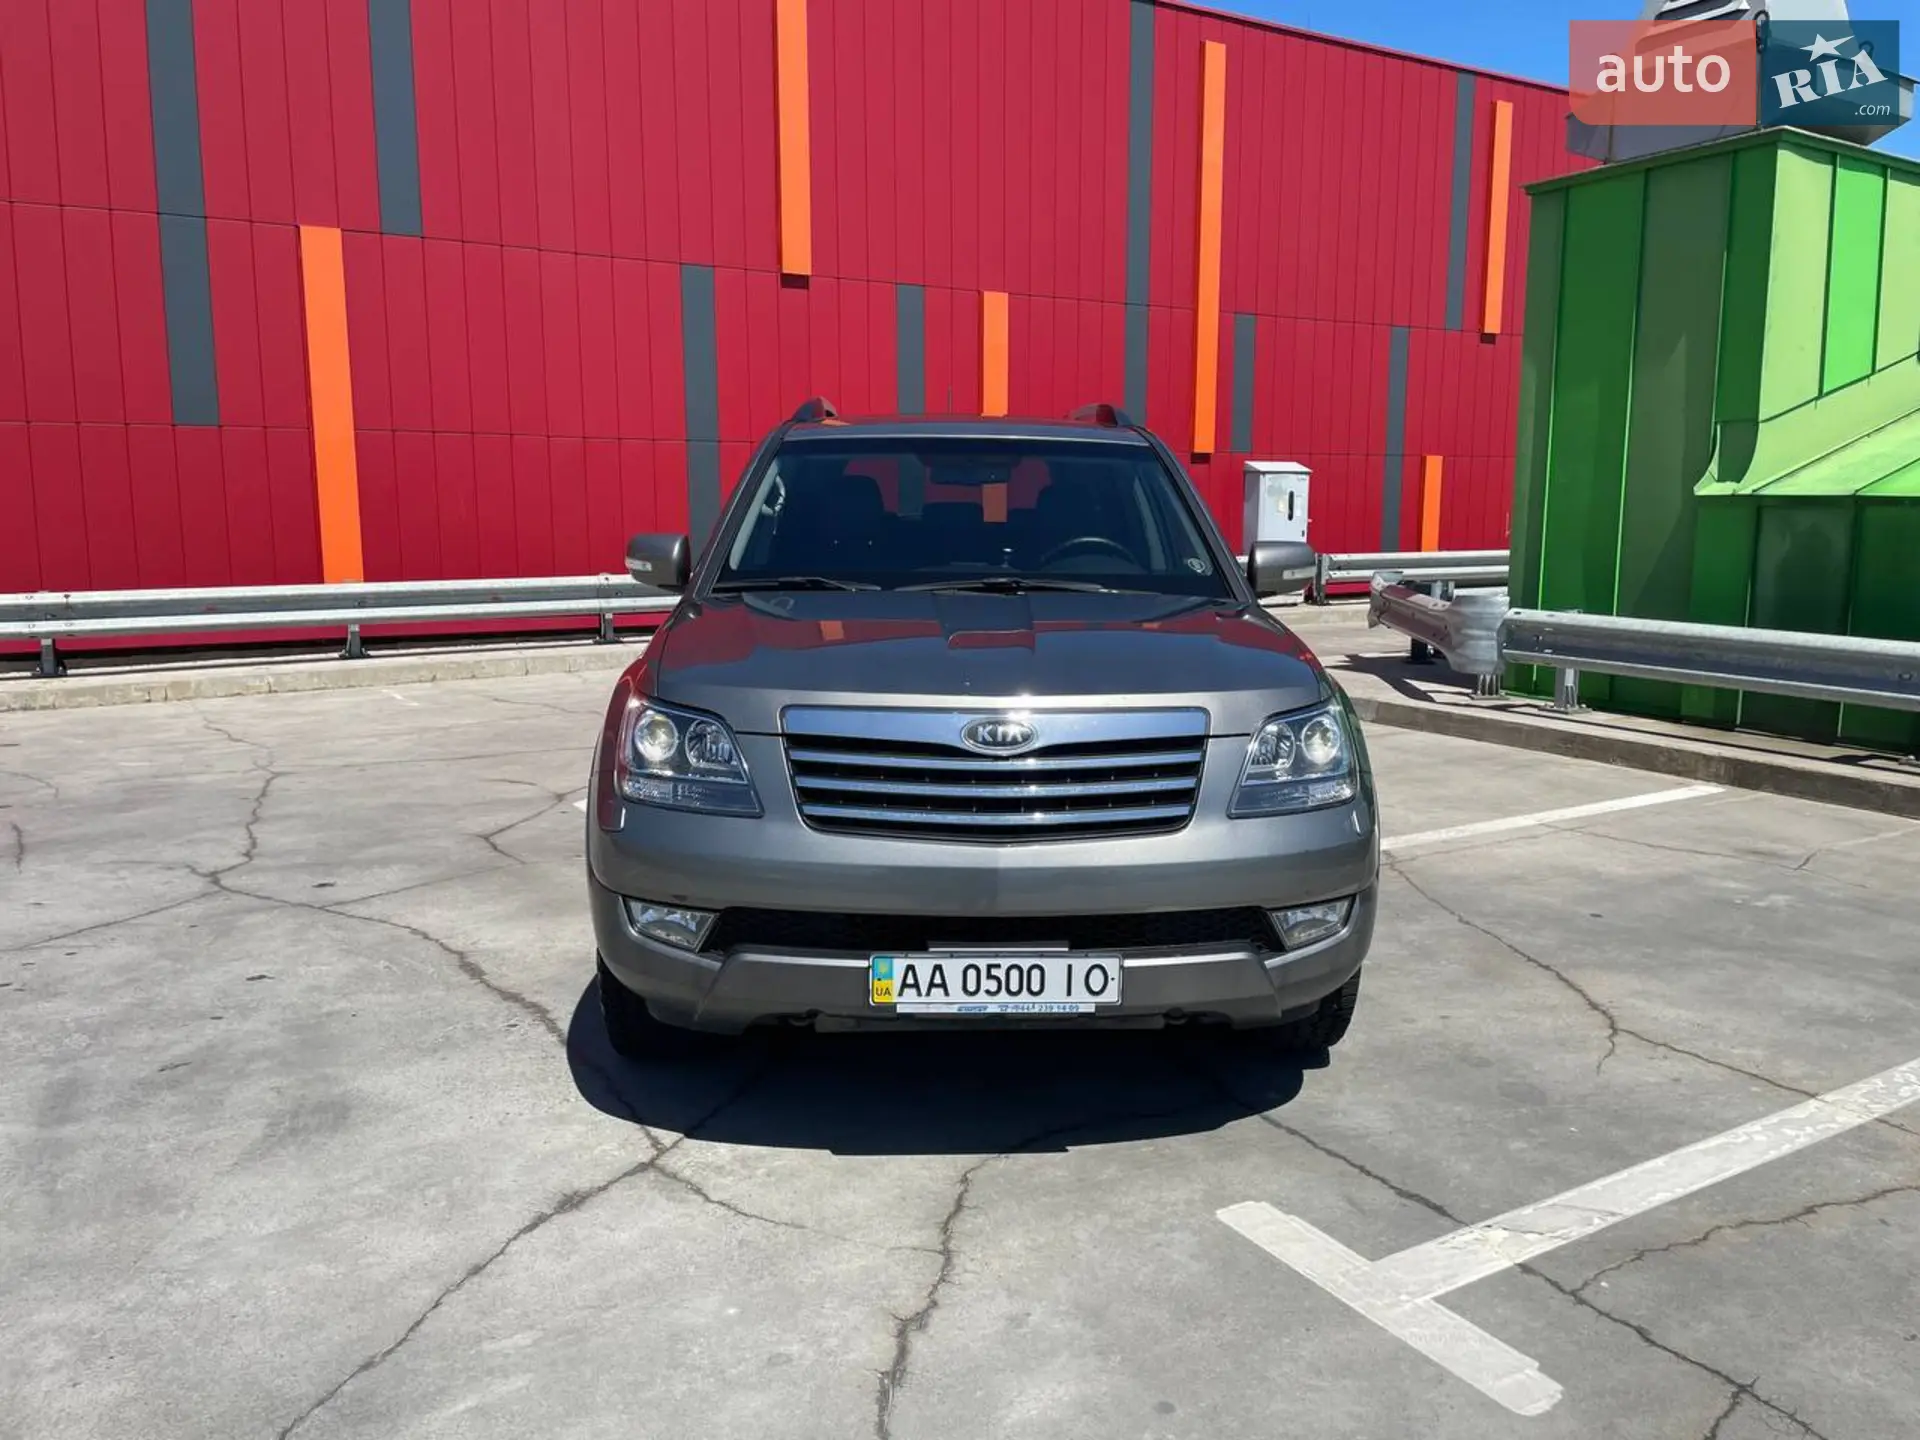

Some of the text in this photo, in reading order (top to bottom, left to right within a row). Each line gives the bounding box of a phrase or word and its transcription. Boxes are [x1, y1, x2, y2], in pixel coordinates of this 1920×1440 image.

[977, 723, 1023, 742] KIA
[898, 964, 949, 997] AA
[962, 964, 1045, 997] 0500
[875, 987, 892, 997] UA
